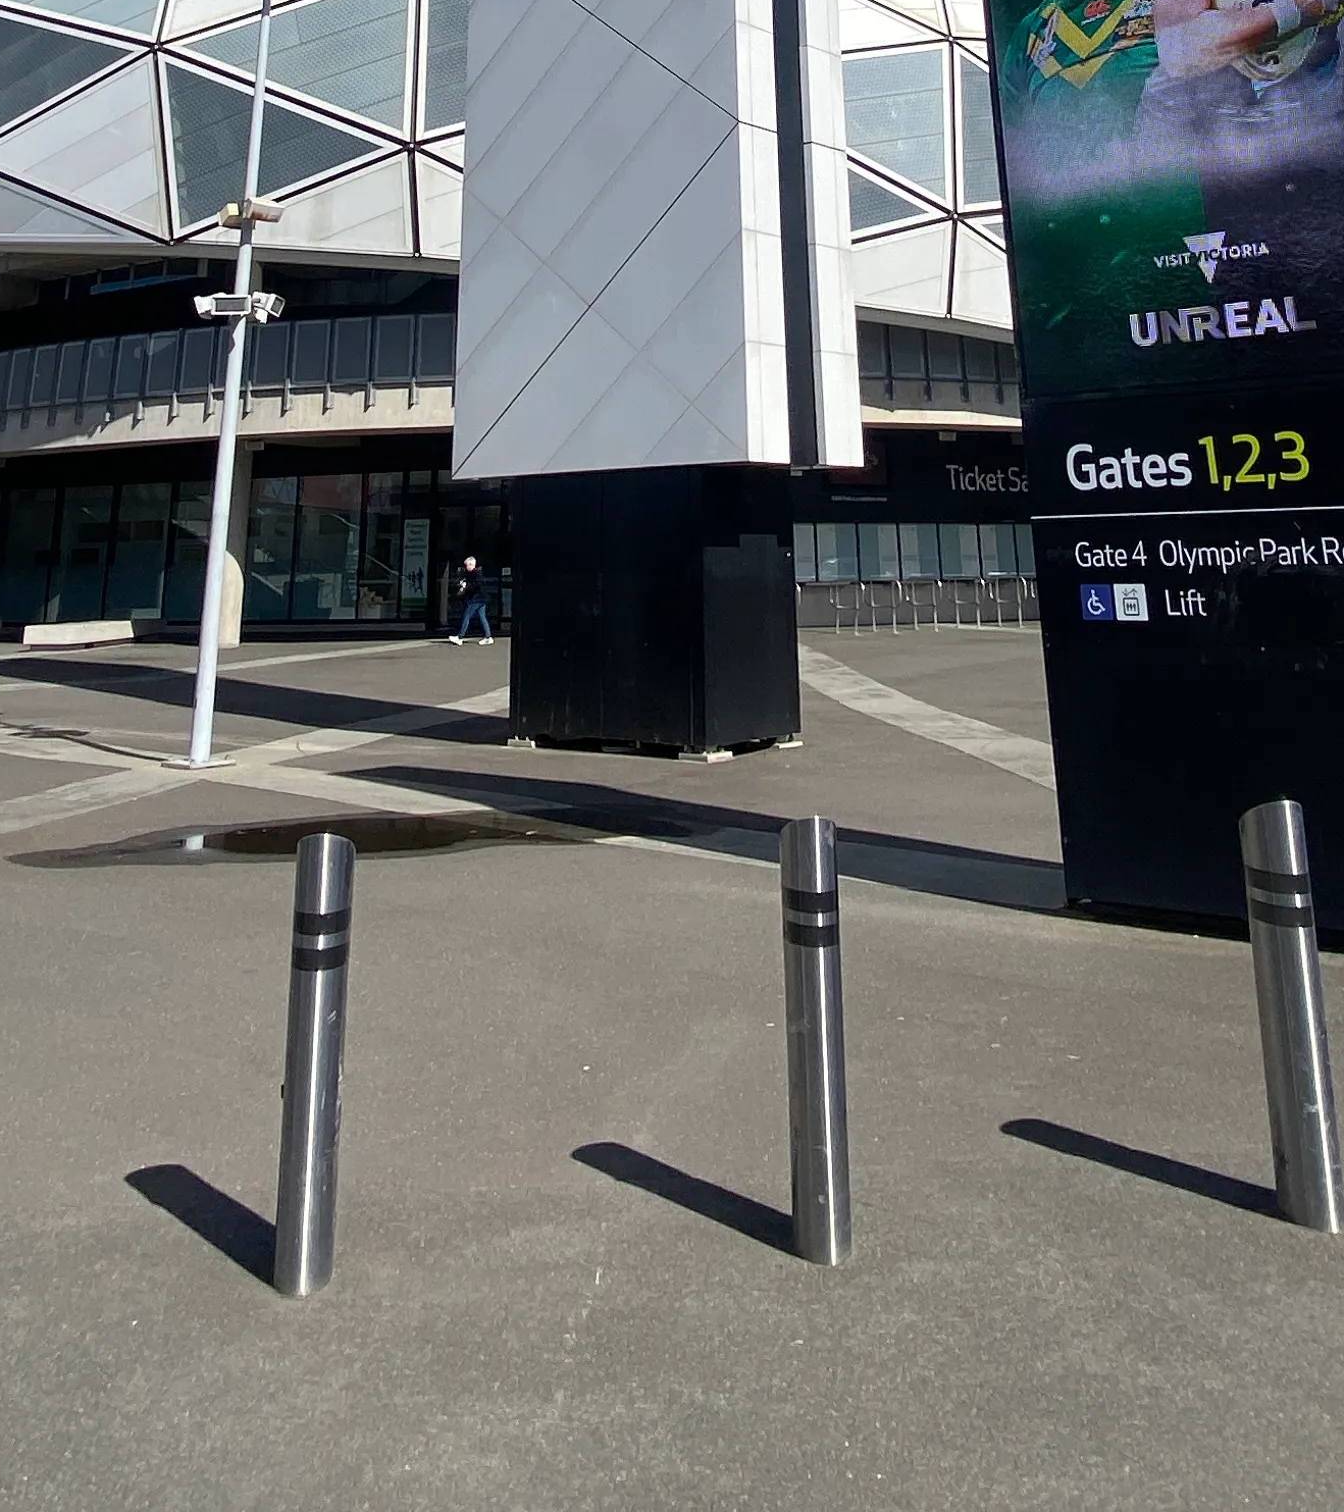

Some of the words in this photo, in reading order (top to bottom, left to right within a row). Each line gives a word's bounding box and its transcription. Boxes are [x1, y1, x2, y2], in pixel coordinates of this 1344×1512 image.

[1153, 252, 1191, 269] VISIT
[1195, 241, 1270, 263] VICTORIA
[1129, 296, 1318, 347] UNREAL
[1066, 443, 1193, 491] Gates
[1198, 431, 1310, 491] 1,2,3
[946, 464, 1006, 491] Ticket
[1008, 467, 1029, 492] Sa
[1075, 541, 1127, 567] Gate
[1132, 540, 1148, 567] 4
[1159, 540, 1256, 574] Olympic
[1259, 537, 1319, 565] Park
[1164, 589, 1207, 617] Lift
